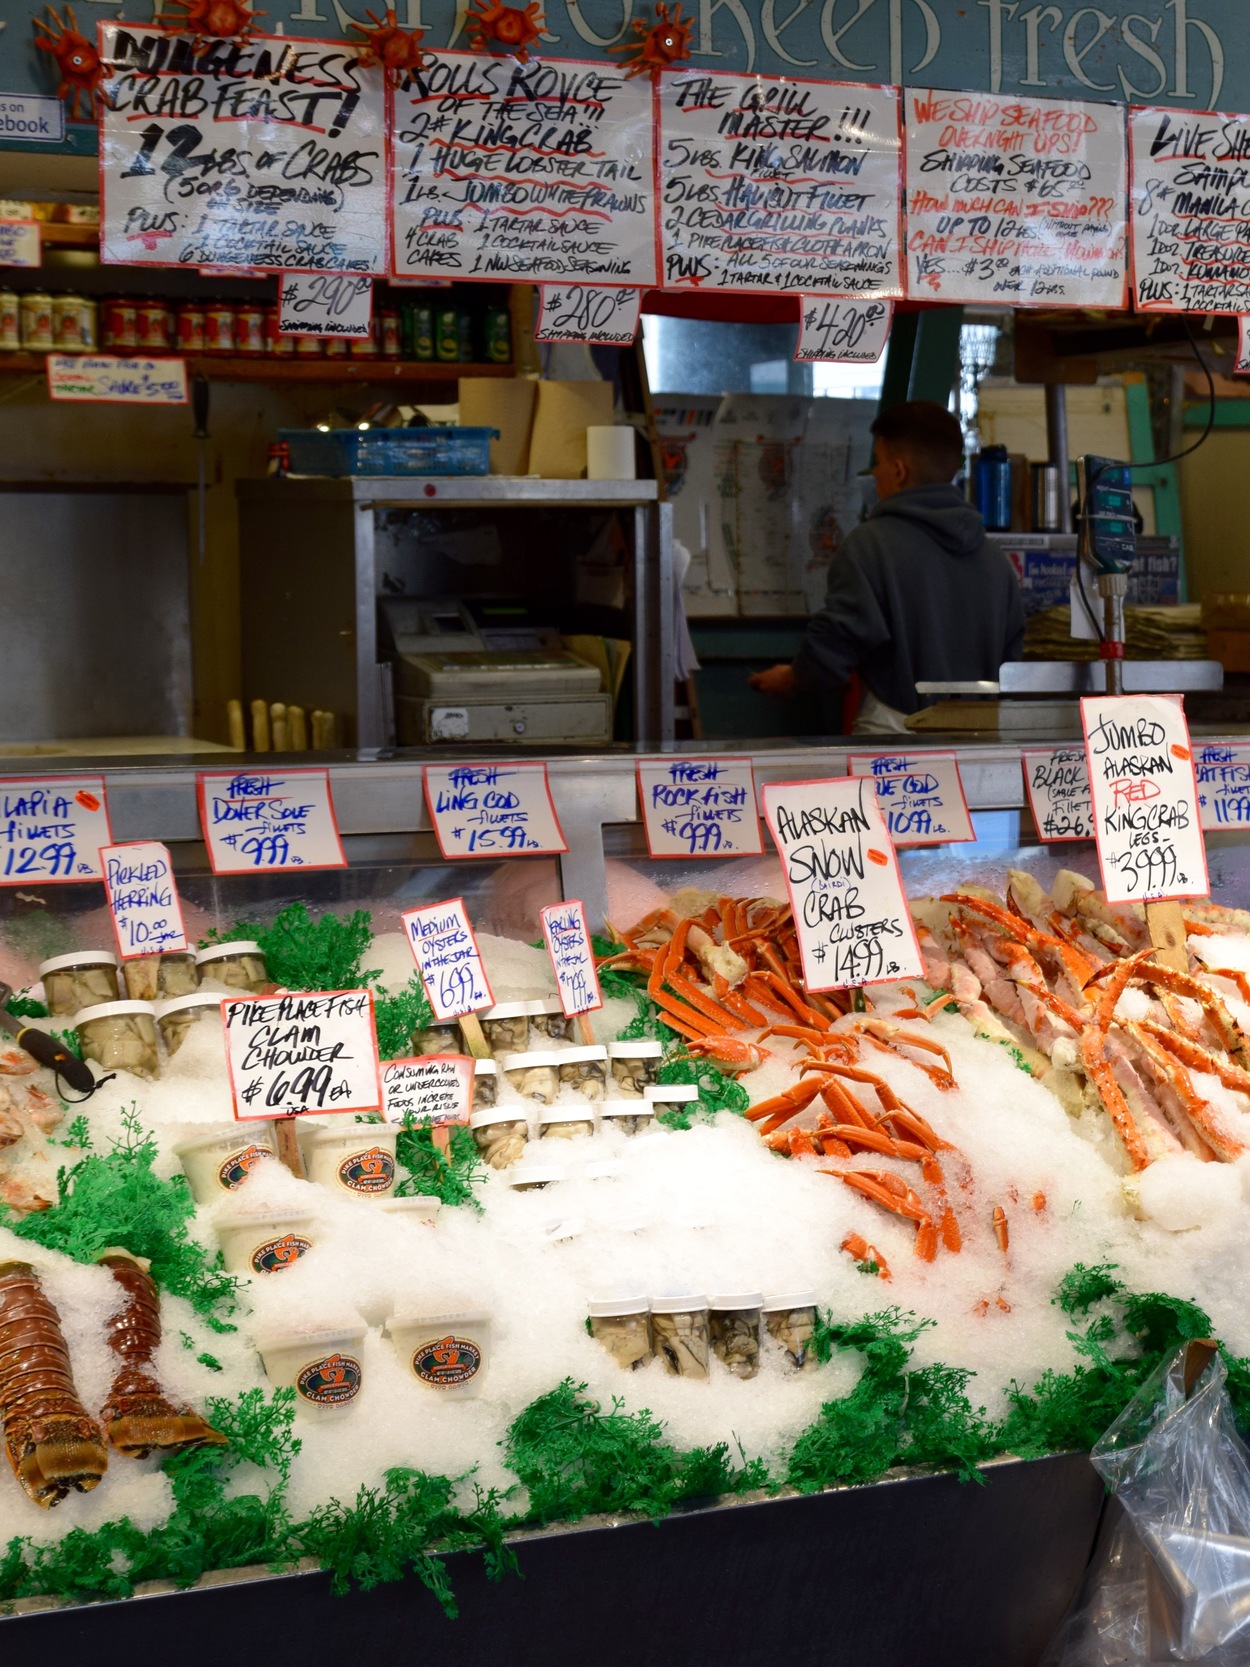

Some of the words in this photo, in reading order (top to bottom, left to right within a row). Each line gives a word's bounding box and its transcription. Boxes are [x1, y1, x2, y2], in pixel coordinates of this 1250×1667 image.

[980, 0, 1225, 112] fresh
[105, 74, 208, 119] CRAB
[672, 78, 738, 108] THE
[437, 97, 475, 113] OF
[480, 100, 527, 122] THE
[1000, 104, 1098, 133] SEAFOOD
[717, 111, 831, 142] MASTER
[282, 140, 379, 187] CRABS
[430, 147, 505, 175] HUGE
[1007, 154, 1091, 180] SEAFOOD
[950, 174, 1018, 194] COSTS
[937, 216, 963, 234] UP
[968, 217, 992, 236] TO
[1088, 713, 1166, 754] JUMBO
[1103, 742, 1173, 779] ALASKAN
[903, 774, 939, 795] COD
[1033, 765, 1084, 789] BLACK
[482, 791, 520, 810] COD
[1109, 778, 1160, 808] RED
[212, 796, 267, 824] DOVER
[268, 800, 315, 822] SOLE
[777, 778, 870, 844] ALASKAN
[1146, 799, 1190, 830] CRAB
[789, 838, 865, 884] SNOW
[804, 887, 865, 928] CRAB
[422, 931, 468, 957] OYSTERS
[830, 919, 903, 944] CLUSTERS
[227, 1000, 281, 1029] PIKE
[278, 996, 328, 1023] PLACE
[249, 1024, 321, 1049] CLAM
[241, 1042, 354, 1071] CHOWDER
[347, 1180, 366, 1191] CLAM
[415, 1353, 425, 1365] PIKE
[424, 1344, 445, 1354] PLACE
[460, 1343, 479, 1359] MARKET
[420, 1371, 440, 1383] CLAM
[442, 1366, 476, 1383] CHOWDER
[306, 1391, 327, 1402] CLAM
[330, 1384, 359, 1402] CHOWDER
